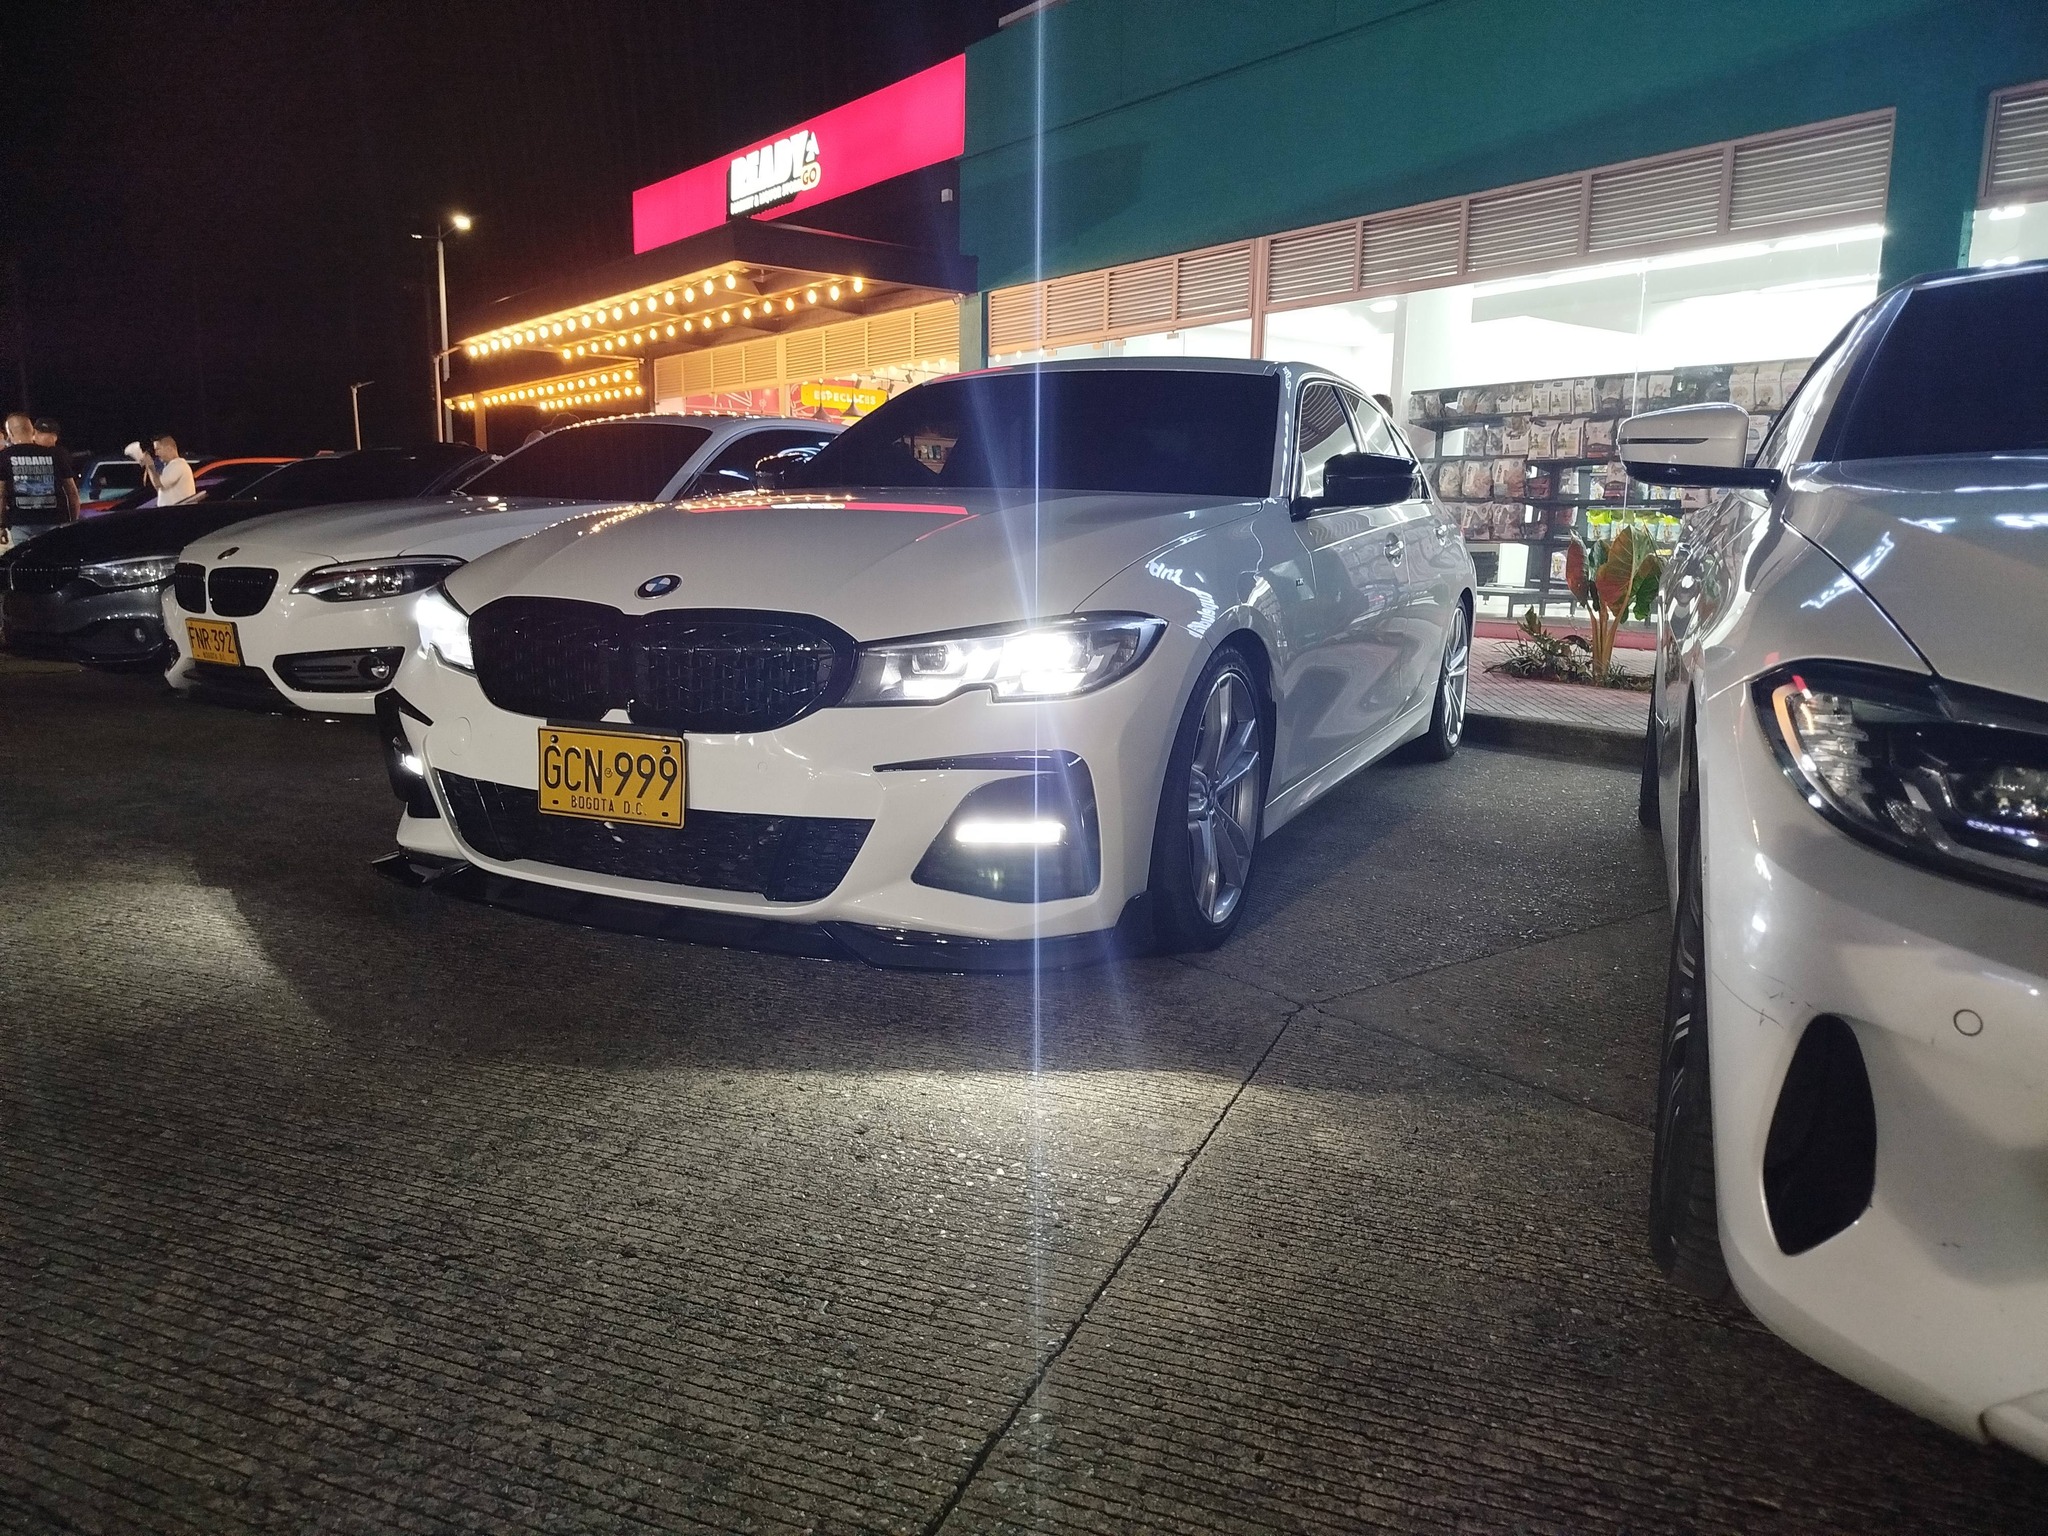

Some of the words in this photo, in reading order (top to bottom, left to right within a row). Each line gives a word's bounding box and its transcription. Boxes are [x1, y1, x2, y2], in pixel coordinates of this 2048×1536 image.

[730, 130, 809, 202] READY
[802, 167, 818, 186] GO
[10, 456, 53, 466] SUBARU
[188, 626, 212, 651] FNR
[211, 629, 235, 654] 392
[544, 745, 603, 794] GCN
[614, 751, 678, 801] 999
[571, 794, 615, 813] BOGOTA
[623, 801, 648, 817] D.C.
